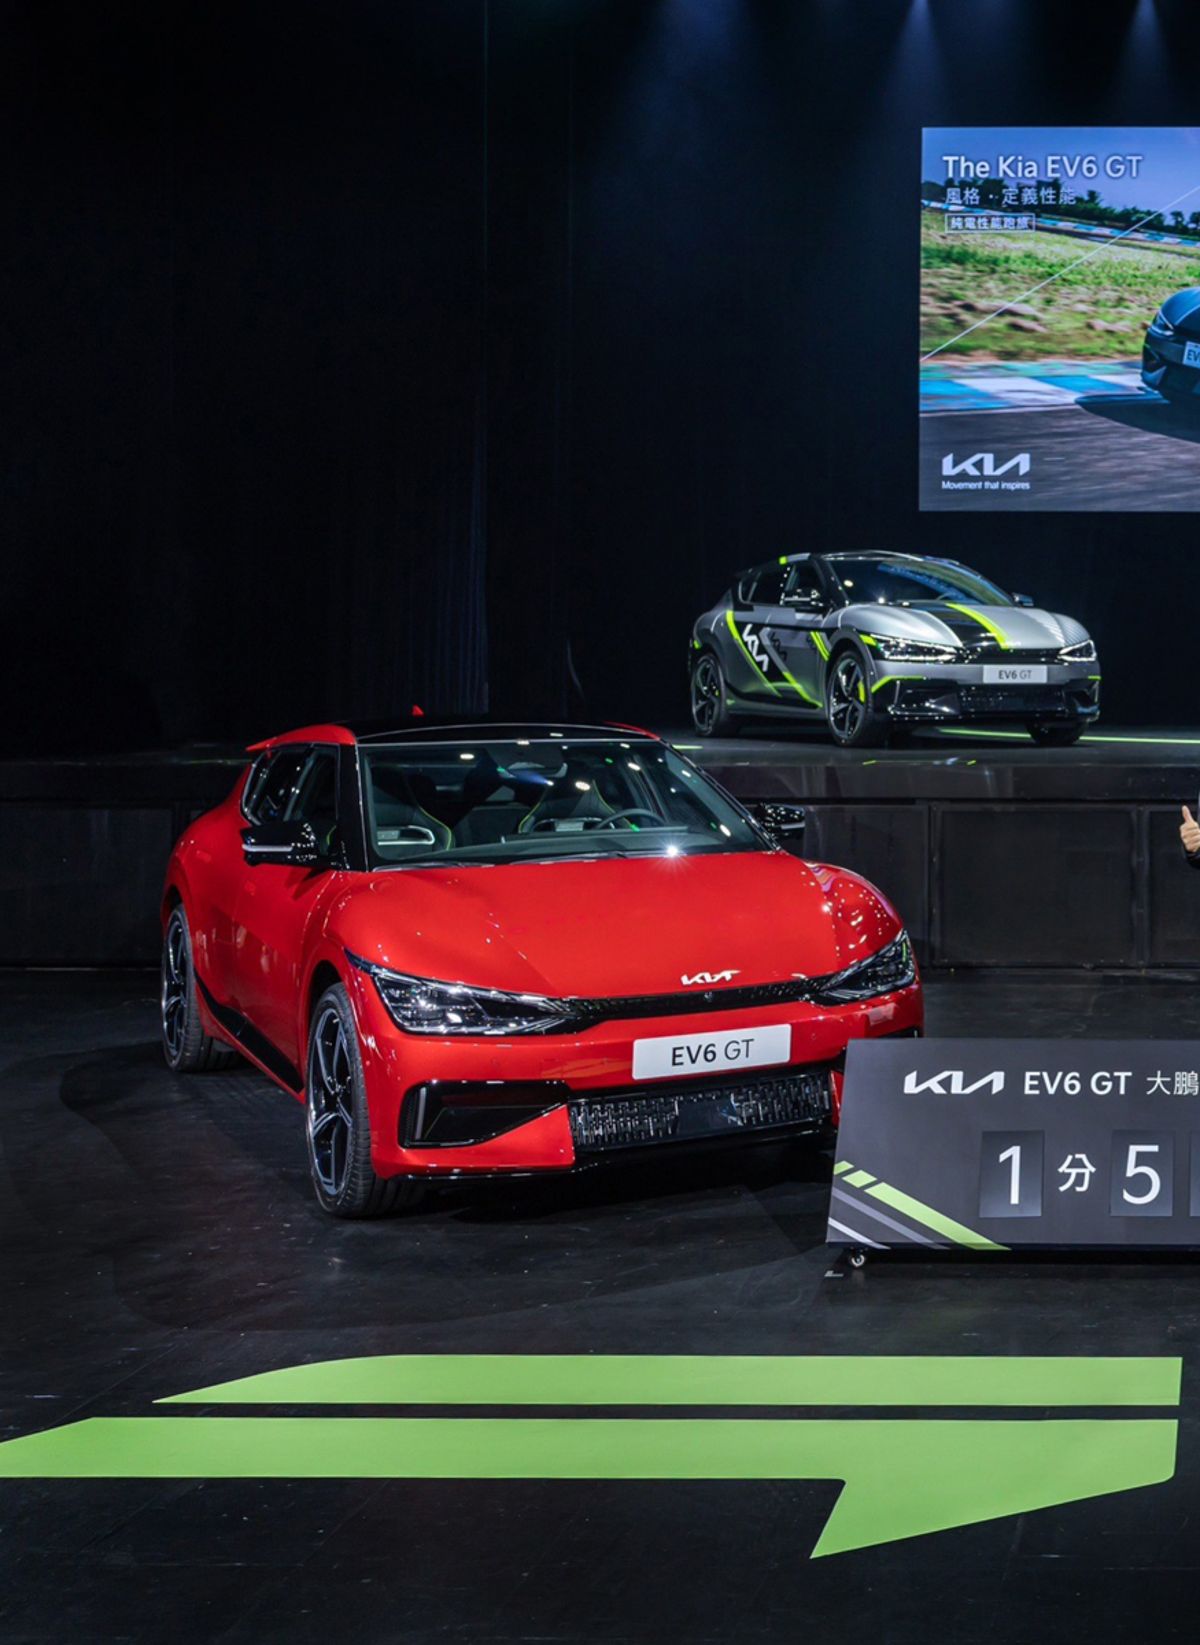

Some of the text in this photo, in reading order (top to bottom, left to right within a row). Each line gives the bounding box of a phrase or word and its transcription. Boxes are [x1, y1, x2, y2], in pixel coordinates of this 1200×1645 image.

[943, 155, 1143, 178] The Kia EV6 GT
[942, 481, 1030, 492] Movement that inspires
[998, 670, 1033, 680] EV6 GT
[671, 1038, 755, 1067] EV6 GT
[1024, 1071, 1081, 1095] EV6
[1090, 1071, 1133, 1095] GT
